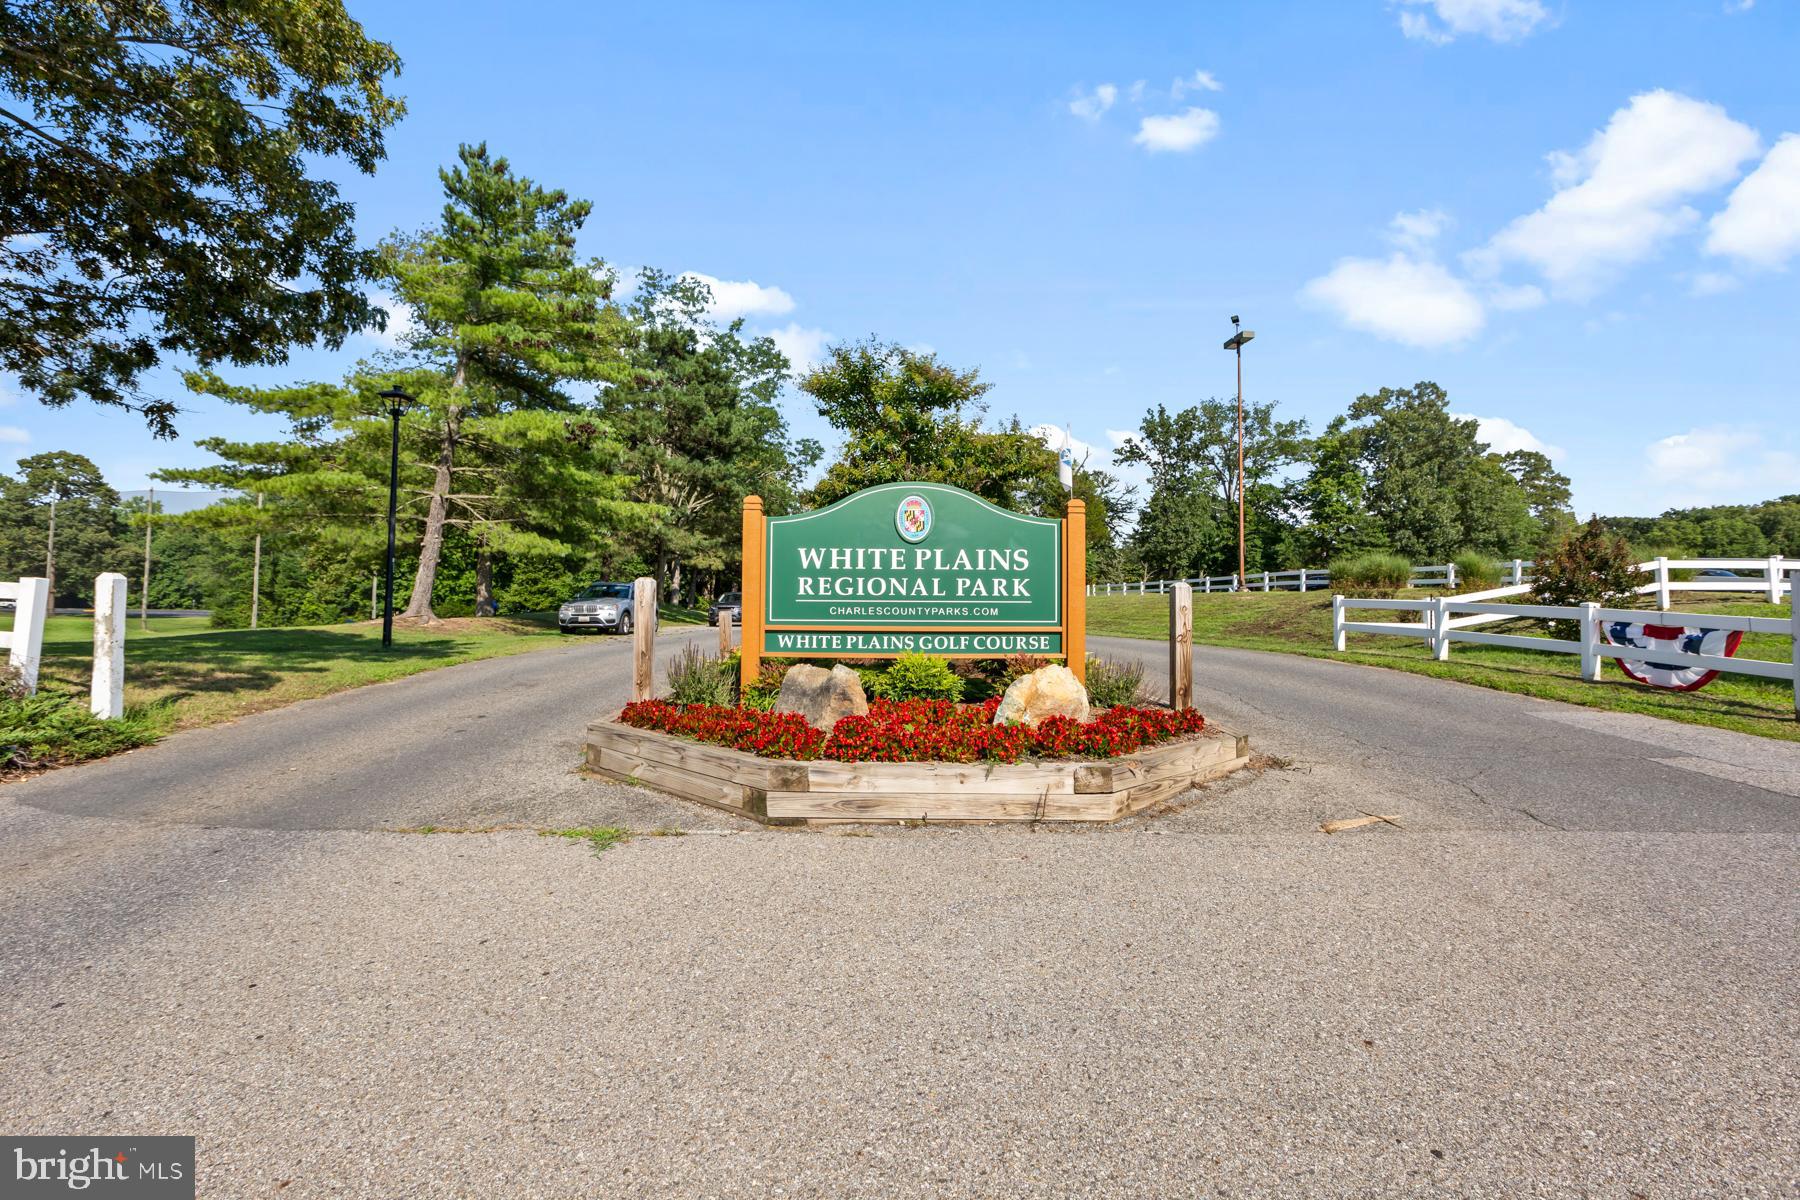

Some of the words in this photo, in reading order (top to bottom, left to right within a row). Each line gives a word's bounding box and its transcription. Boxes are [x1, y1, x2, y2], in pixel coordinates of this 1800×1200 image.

[798, 547, 906, 571] WHITE
[914, 548, 1030, 571] PLAINS
[797, 576, 946, 596] REGIONAL
[956, 577, 1031, 597] PARK
[829, 606, 999, 616] CHARLESCOUNTYPARKS.COM
[777, 634, 842, 649] WHITE
[846, 635, 915, 650] PLAINS
[919, 635, 970, 650] GOLF
[973, 635, 1050, 650] COURSE
